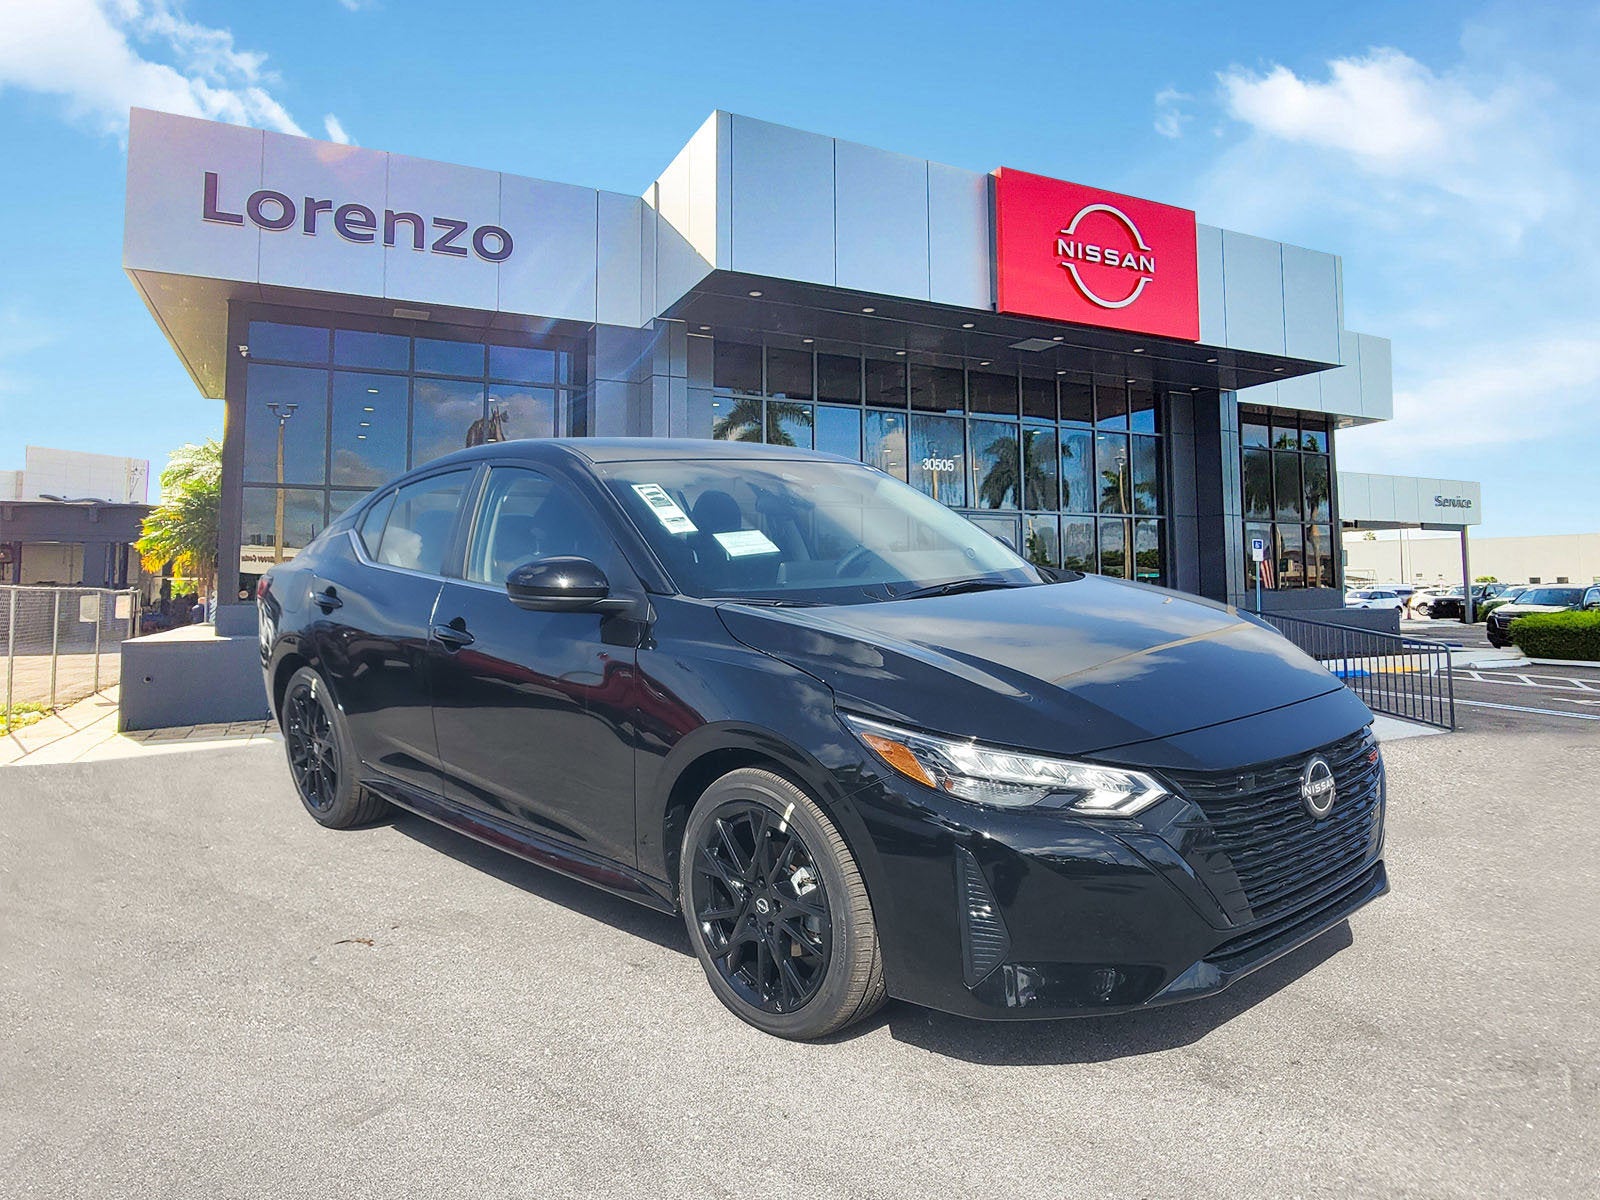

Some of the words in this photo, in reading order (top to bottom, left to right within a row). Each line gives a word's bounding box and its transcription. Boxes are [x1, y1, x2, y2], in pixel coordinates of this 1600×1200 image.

[202, 171, 514, 263] Lorenzo
[1057, 238, 1155, 273] NISSAN
[922, 457, 955, 472] 30505
[1434, 495, 1473, 509] Service
